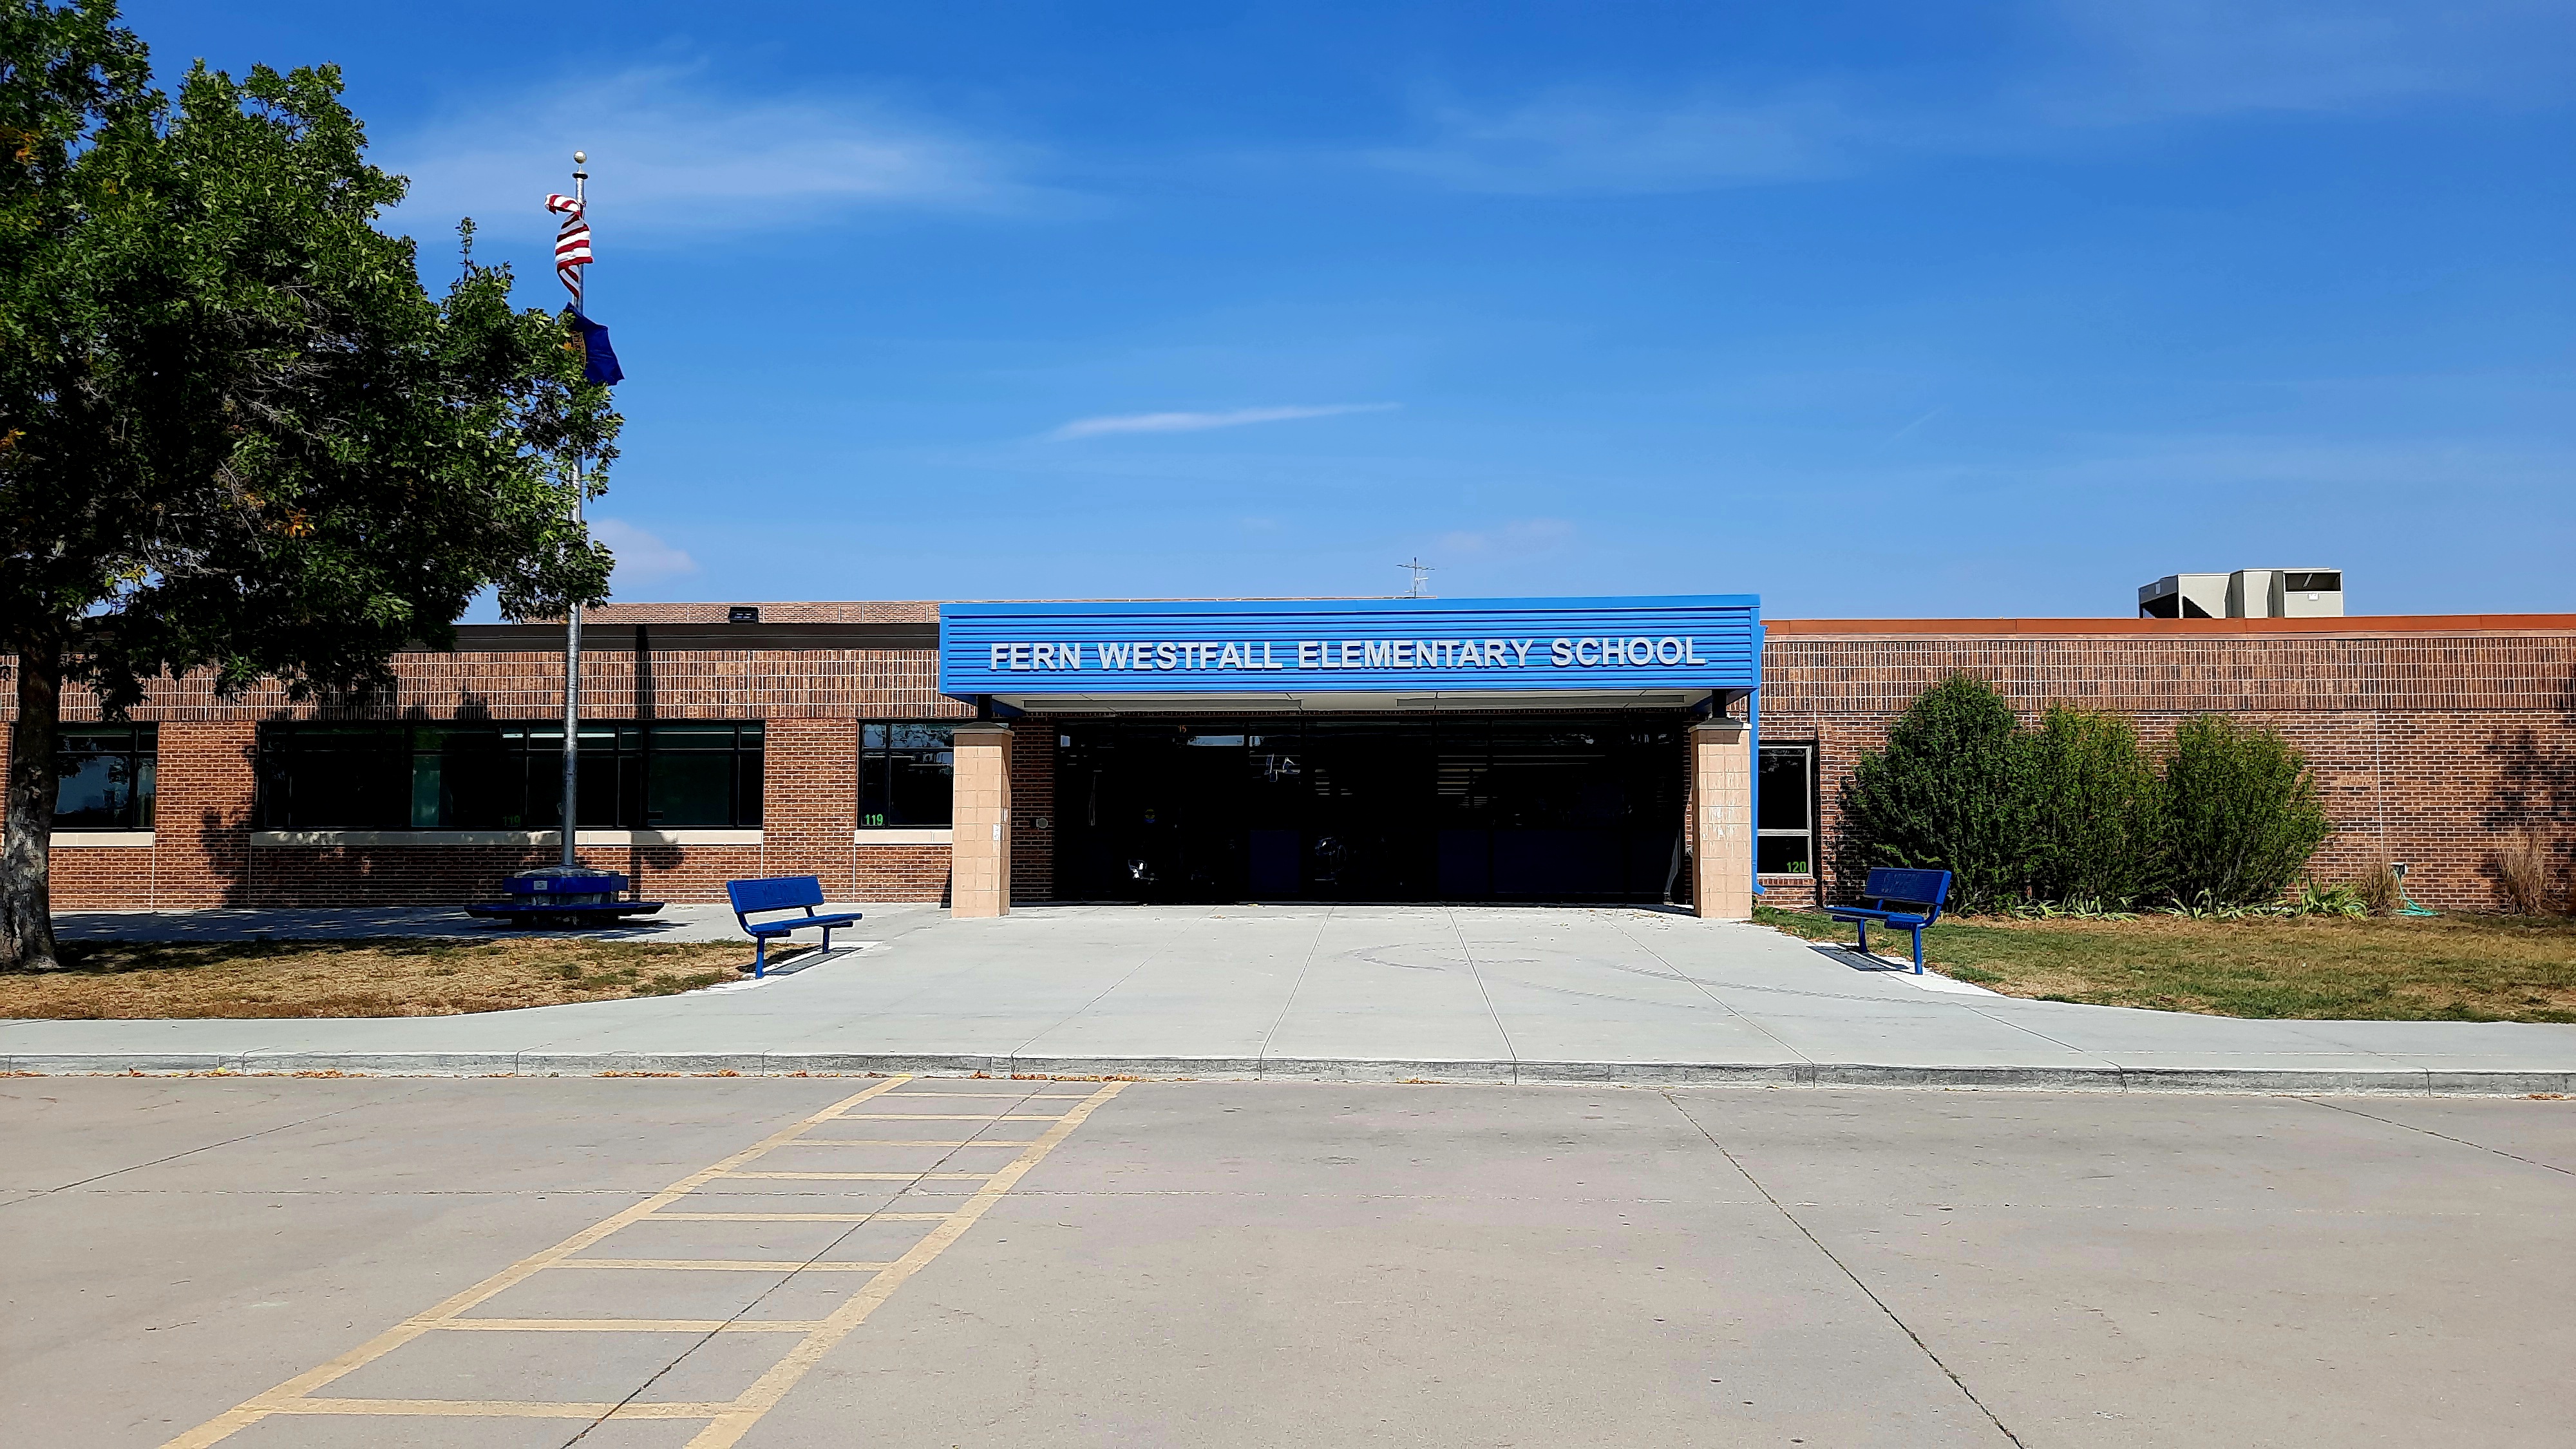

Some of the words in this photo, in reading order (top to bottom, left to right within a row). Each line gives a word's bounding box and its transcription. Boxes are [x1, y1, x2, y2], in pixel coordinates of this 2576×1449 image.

[990, 642, 1081, 670] FERN
[1097, 641, 1285, 670] WESTFALL
[1298, 638, 1535, 668] ELEMENTARY
[1550, 636, 1707, 666] SCHOOL
[866, 813, 884, 826] 119
[1786, 861, 1806, 873] 120
